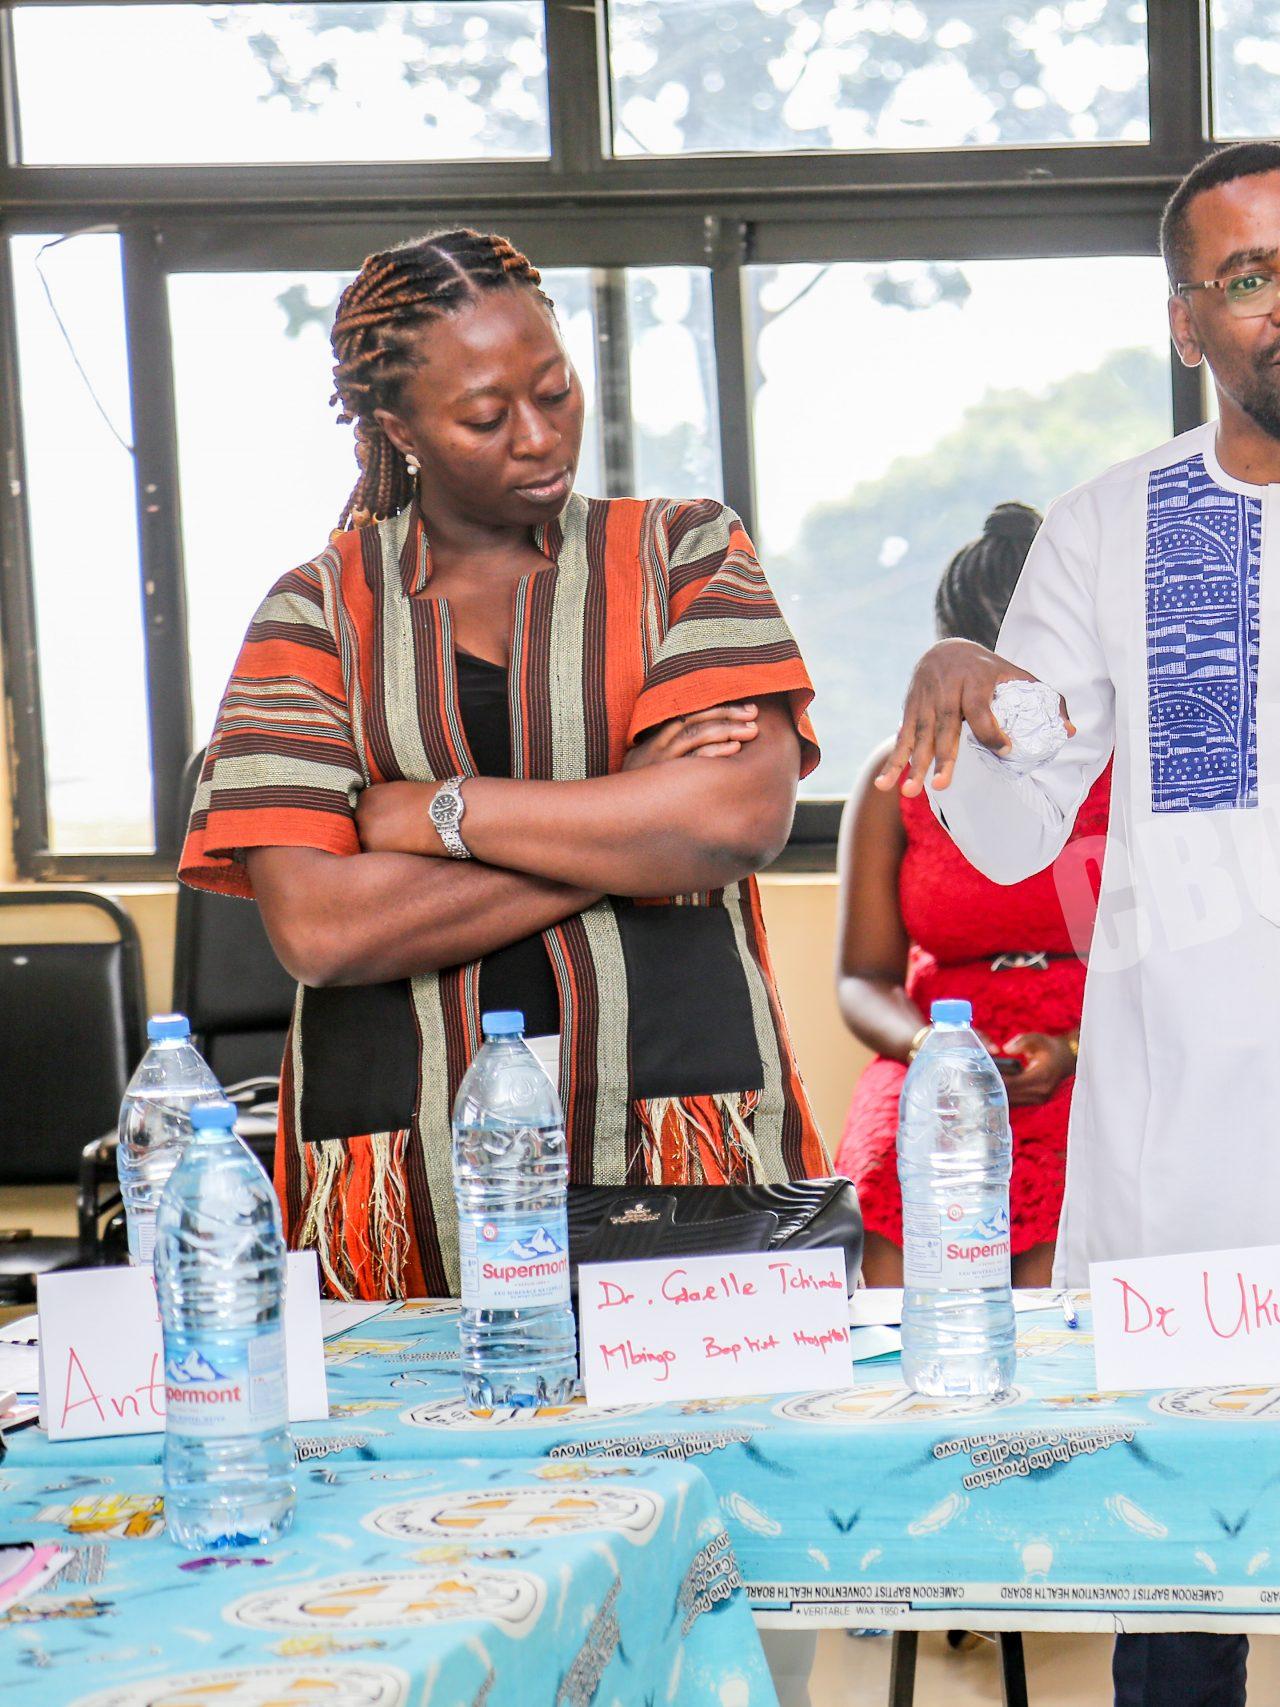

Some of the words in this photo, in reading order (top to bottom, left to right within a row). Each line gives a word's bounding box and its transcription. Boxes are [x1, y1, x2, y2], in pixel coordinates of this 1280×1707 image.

[1112, 1277, 1180, 1337] Dr
[600, 1340, 677, 1381] Mbingo
[933, 1436, 969, 1459] Love
[991, 1445, 1009, 1464] all
[1010, 1441, 1026, 1455] to
[972, 1451, 989, 1466] as
[1030, 1451, 1052, 1469] the
[964, 1461, 1028, 1490] Provision
[777, 1585, 813, 1599] HEALTH
[814, 1585, 873, 1599] CONVENTION
[875, 1586, 912, 1599] BAPTIST
[913, 1586, 965, 1599] CAMEROON
[1000, 1587, 1032, 1600] BOARD
[1034, 1587, 1069, 1600] HEALTH
[1070, 1587, 1130, 1601] CONVENTION
[1132, 1588, 1170, 1602] BAPTIST
[1172, 1588, 1224, 1602] CAMEROON
[803, 1606, 850, 1617] VERITABLE
[856, 1606, 876, 1616] WAX
[880, 1606, 899, 1617] 1950
